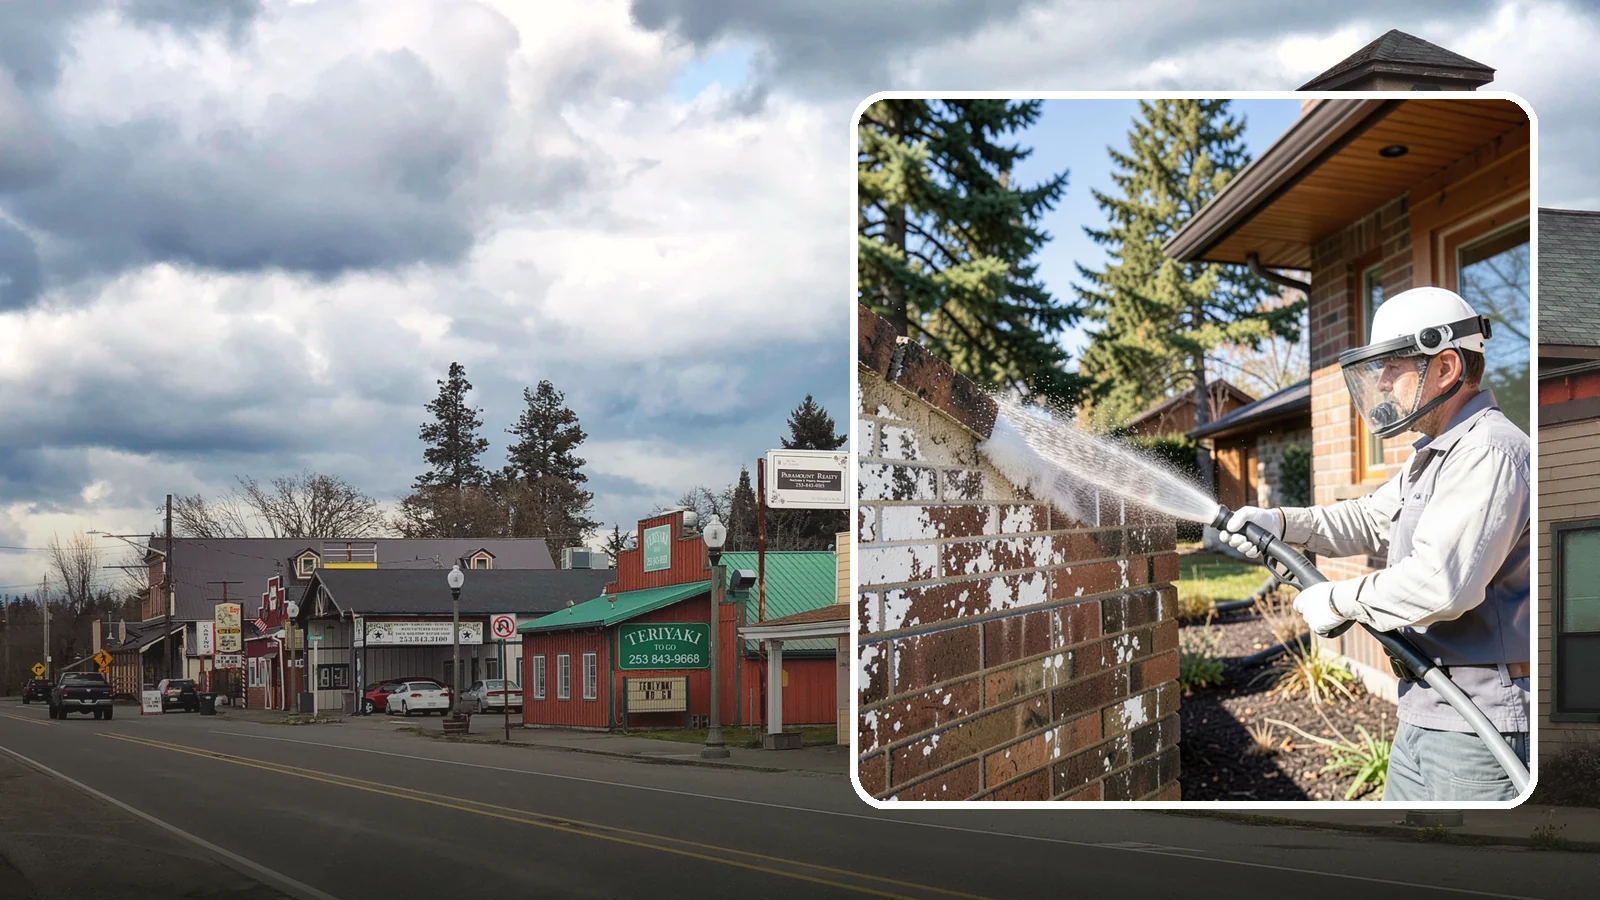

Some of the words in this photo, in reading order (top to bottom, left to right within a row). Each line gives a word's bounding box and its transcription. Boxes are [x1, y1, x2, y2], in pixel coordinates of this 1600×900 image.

[781, 471, 815, 479] PARAMOUNT
[817, 472, 839, 480] REALTY
[624, 627, 703, 646] TERIYAKI
[628, 654, 649, 665] 253
[651, 653, 700, 664] 843-9668
